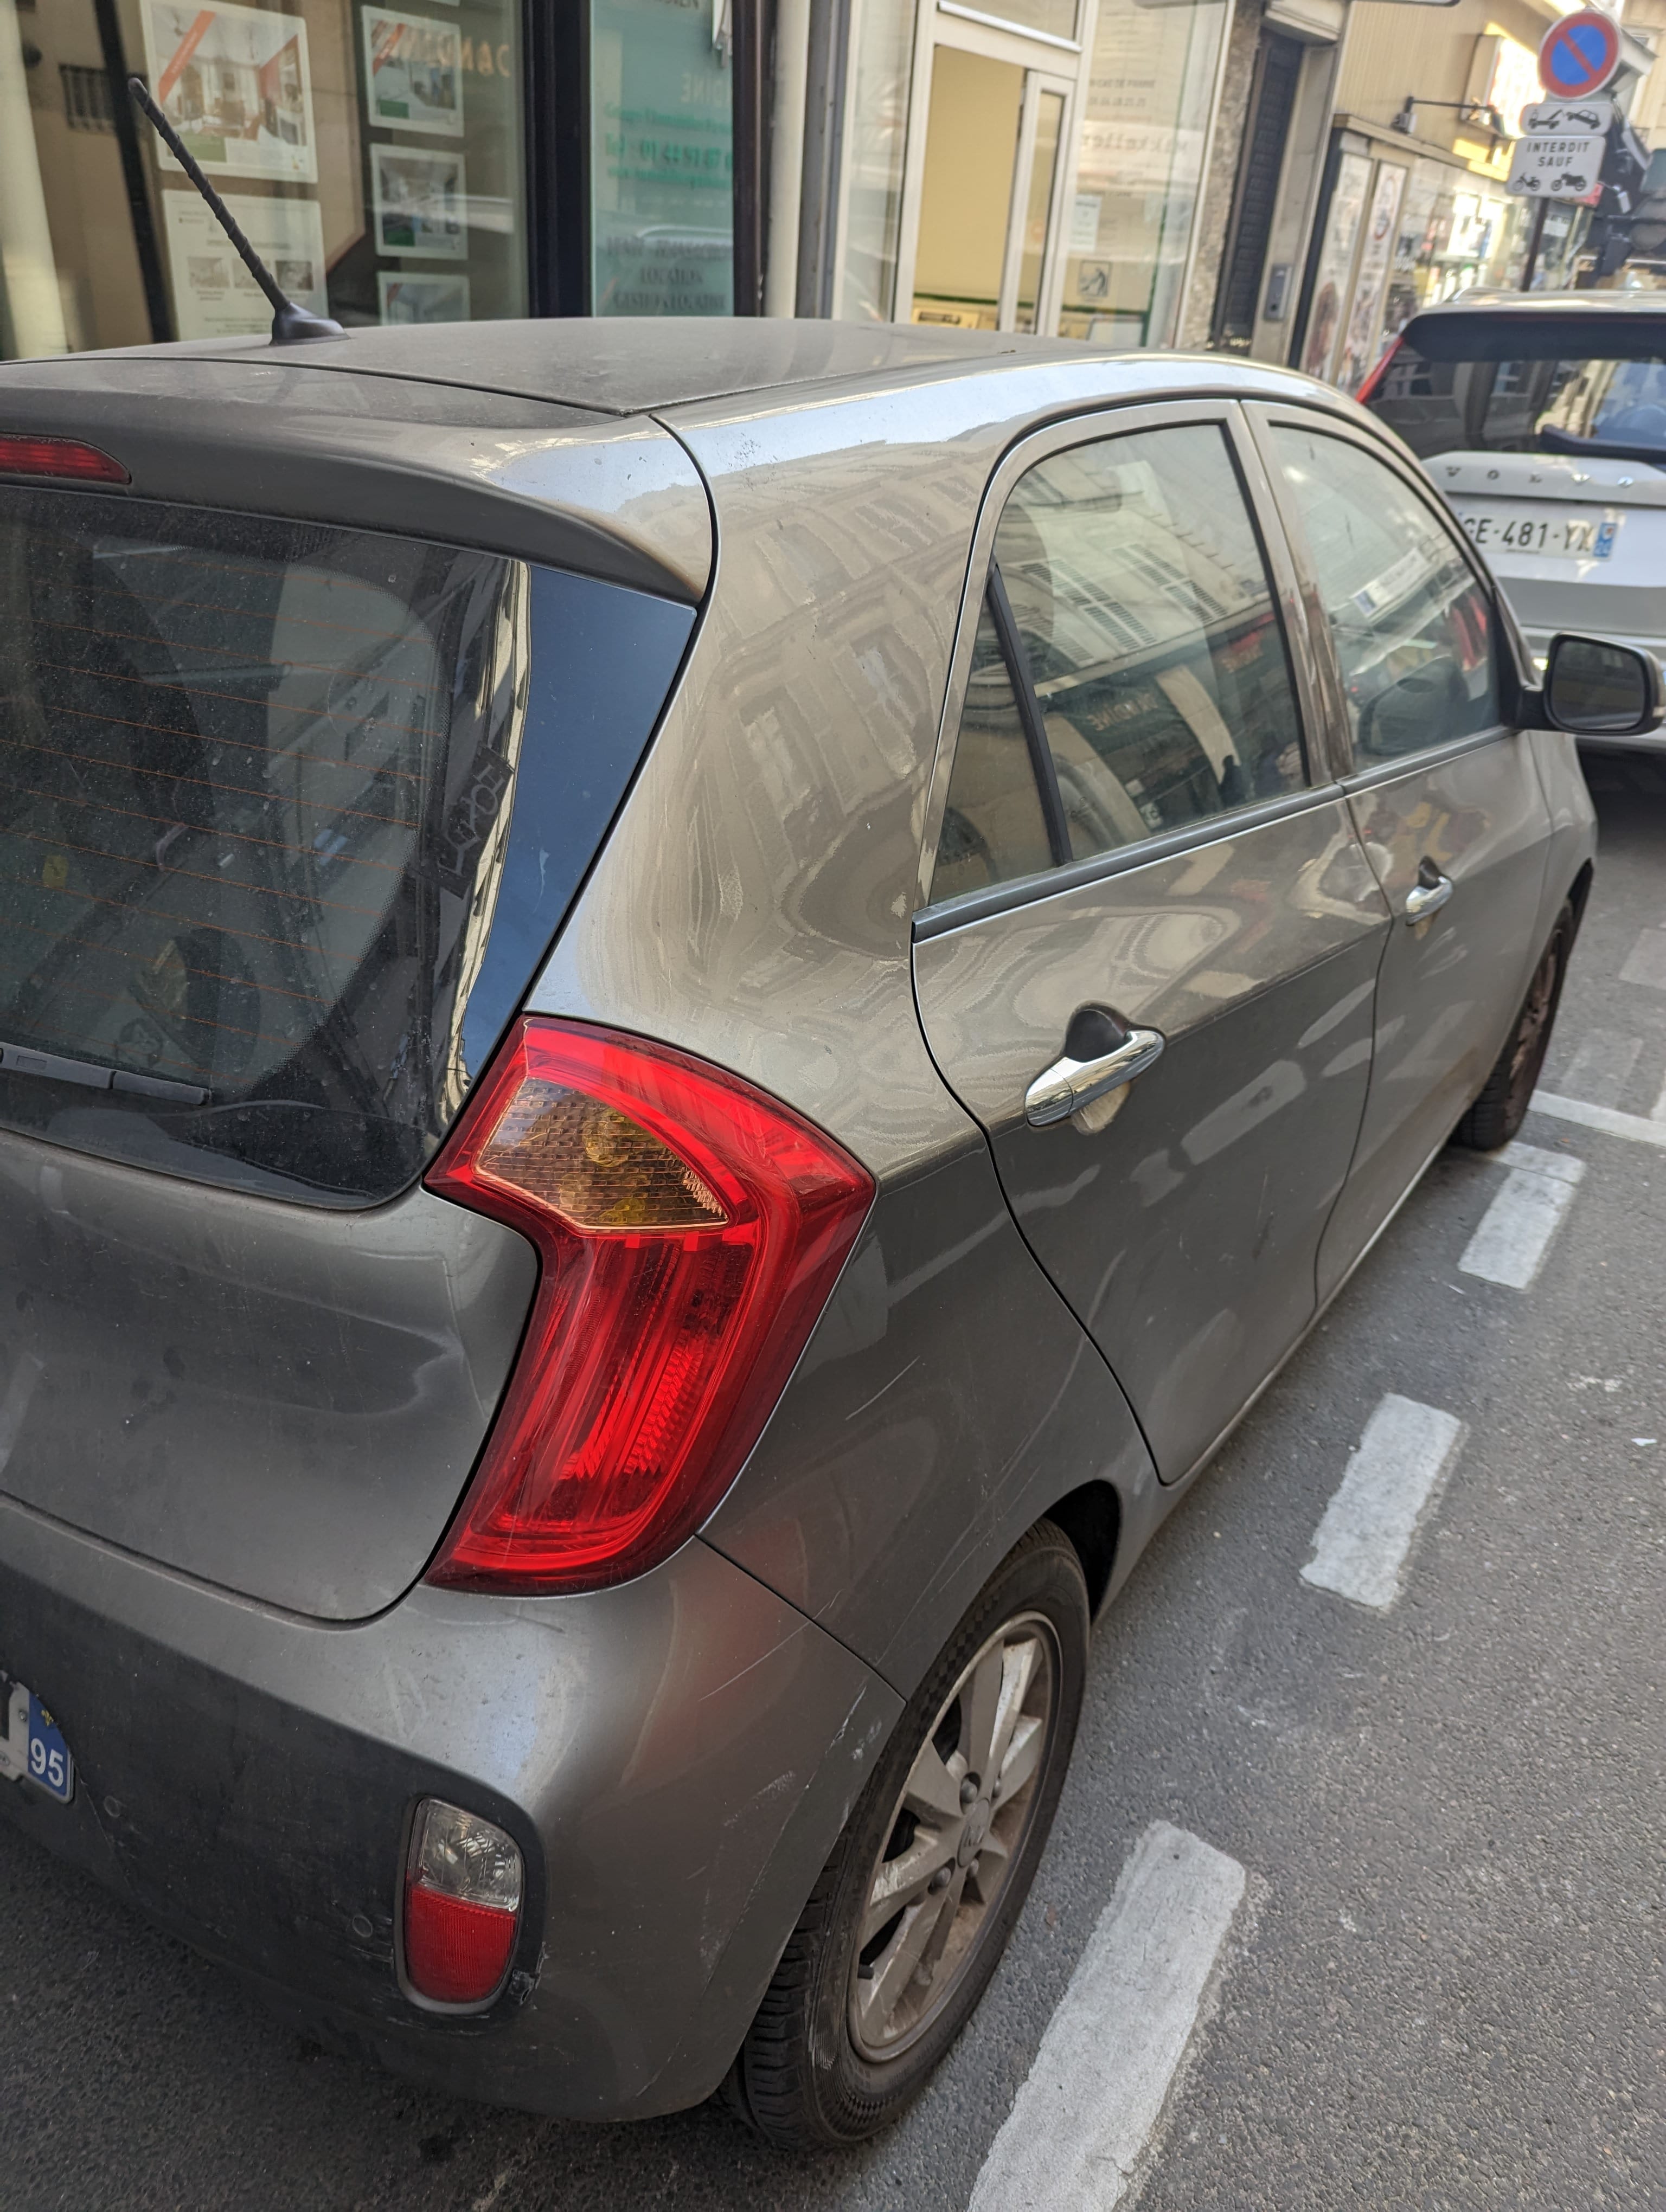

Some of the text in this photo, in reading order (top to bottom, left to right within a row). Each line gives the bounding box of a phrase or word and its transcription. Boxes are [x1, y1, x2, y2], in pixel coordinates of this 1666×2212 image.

[1527, 142, 1590, 152] INTERDIT
[1537, 156, 1574, 167] SAUF
[1445, 465, 1634, 488] VOLVO
[31, 1738, 63, 1787] 95
